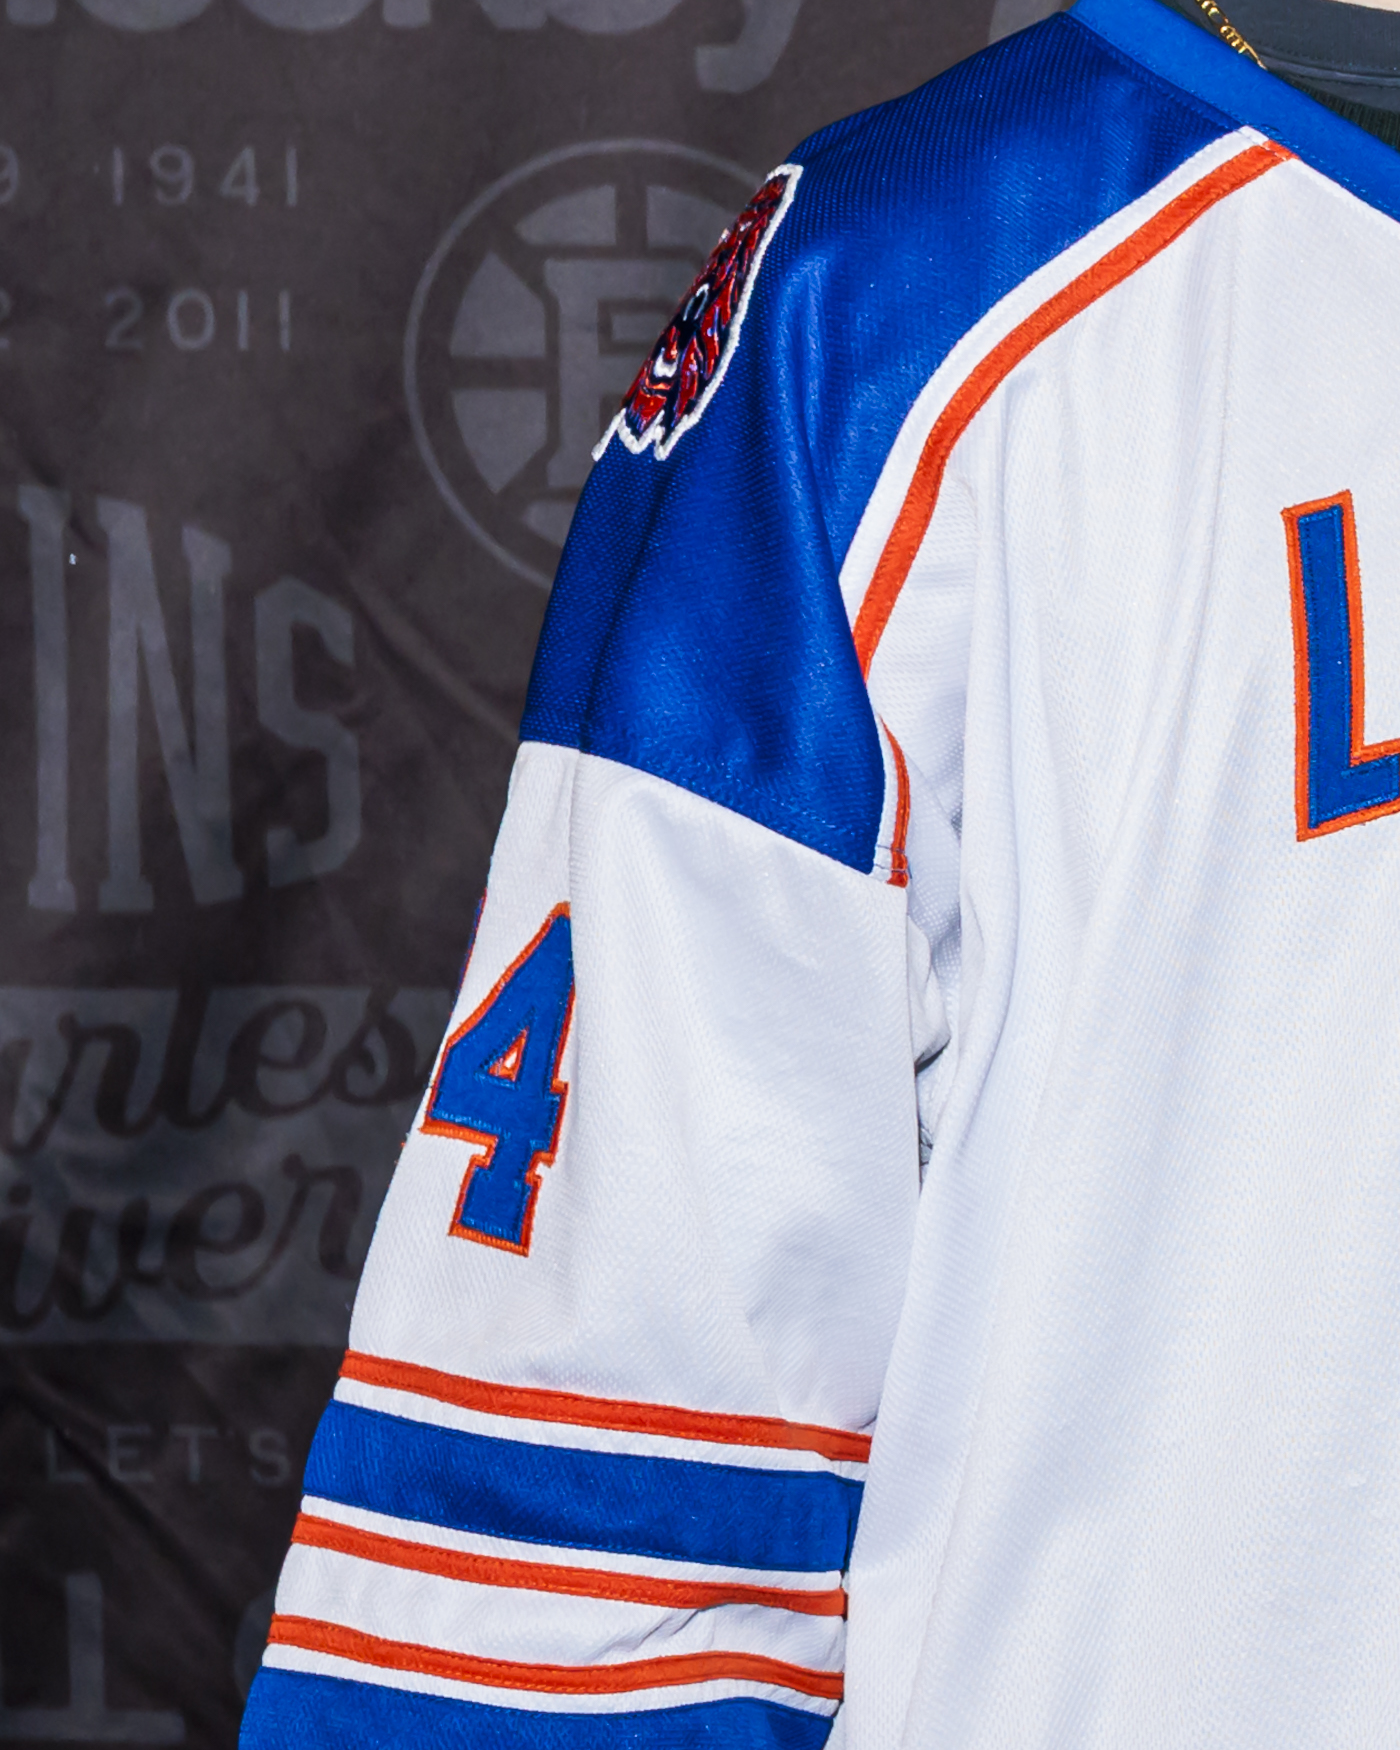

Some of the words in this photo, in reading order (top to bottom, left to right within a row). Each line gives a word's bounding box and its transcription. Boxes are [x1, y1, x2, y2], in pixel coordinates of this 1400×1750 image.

[111, 142, 301, 207] 1941
[104, 286, 293, 352] 2011
[418, 900, 576, 1258] 4
[44, 1422, 293, 1488] LET'S
